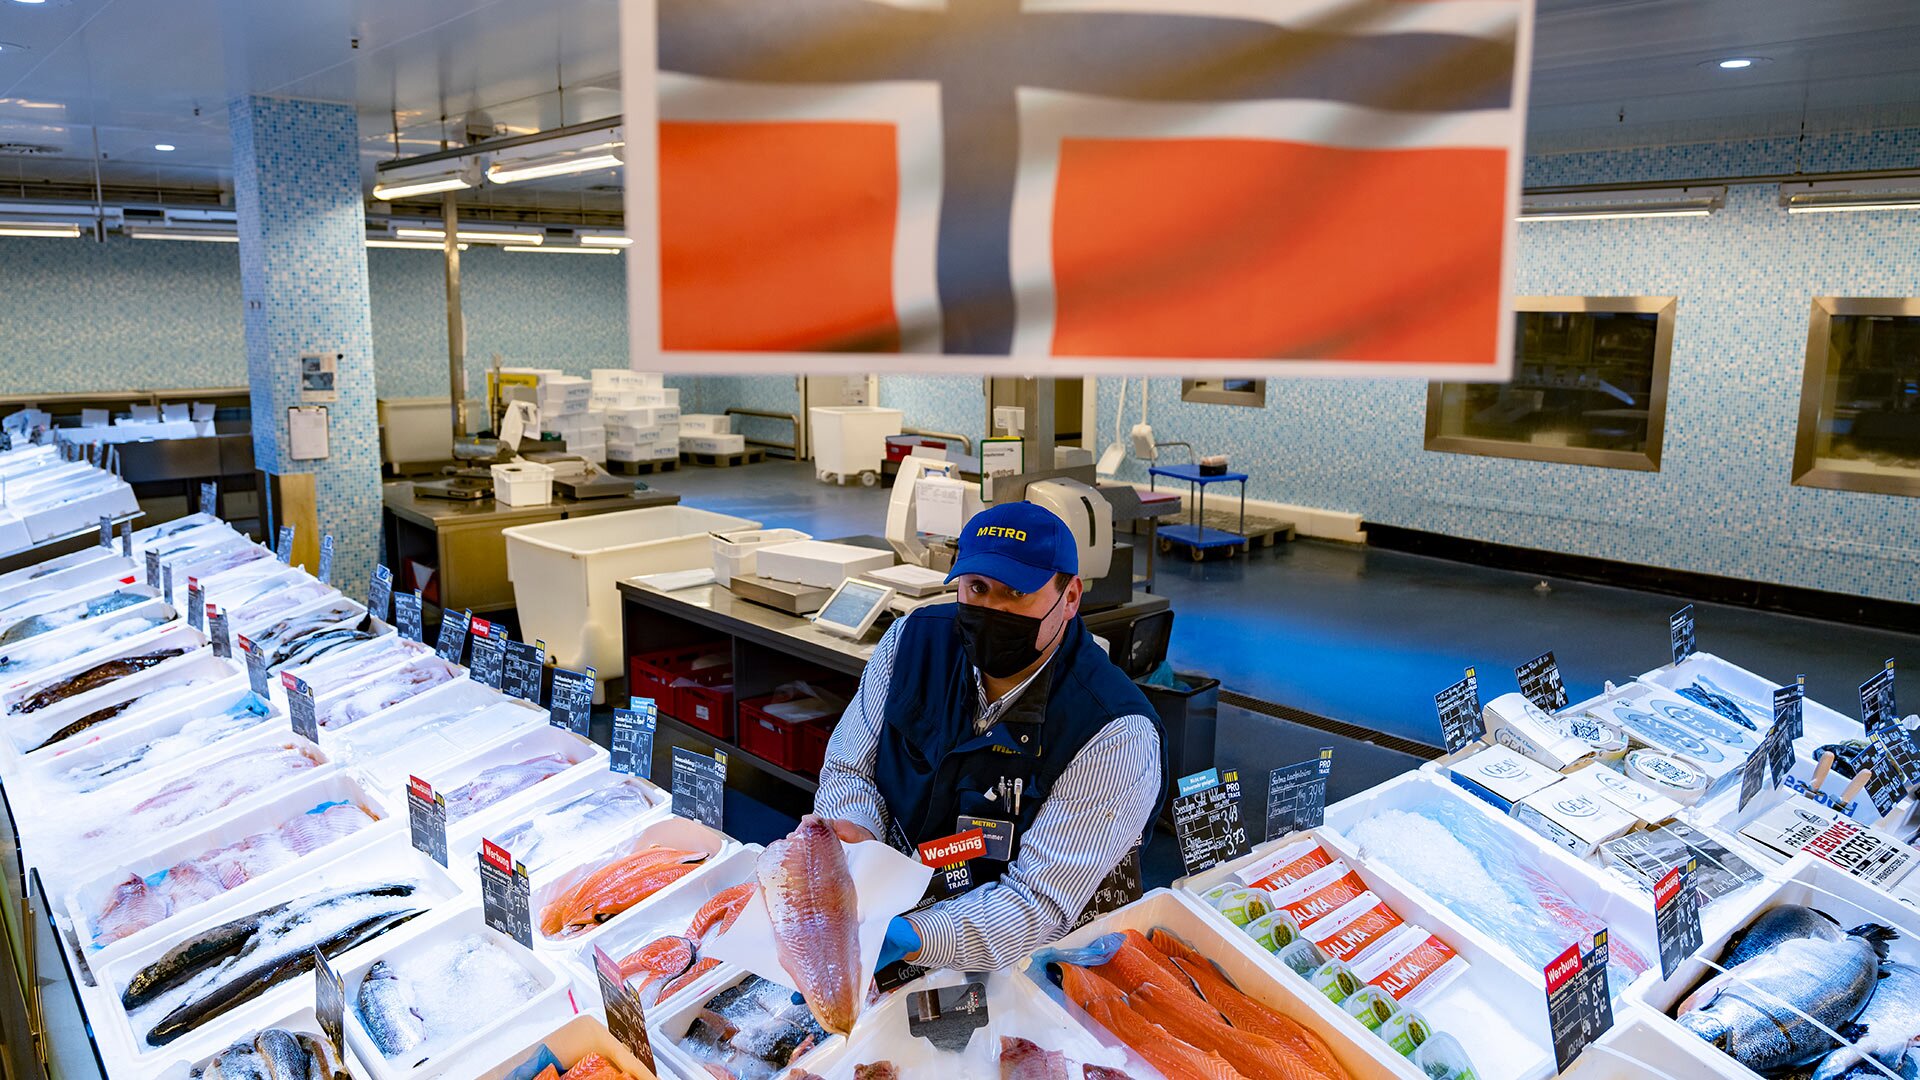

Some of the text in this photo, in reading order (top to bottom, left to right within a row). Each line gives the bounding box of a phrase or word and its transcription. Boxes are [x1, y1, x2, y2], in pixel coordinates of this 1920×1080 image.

[976, 526, 1027, 542] METRO
[647, 715, 656, 725] PRO
[715, 763, 726, 773] PRO
[1319, 759, 1331, 769] PRO
[1484, 757, 1520, 774] GEAY
[1226, 783, 1240, 793] PRO
[1227, 791, 1241, 799] TRACE
[1557, 793, 1593, 815] GEAY
[971, 819, 997, 829] METRO
[1221, 805, 1238, 834] 3,49
[983, 833, 1005, 842] ammer
[1226, 828, 1246, 856] 3,73
[1568, 838, 1577, 849] 2
[1784, 825, 1819, 849] PREMIER
[484, 844, 510, 871] Werbung
[924, 838, 982, 862] Werbung
[945, 868, 968, 884] PRO
[947, 878, 970, 890] TRACE
[1655, 872, 1680, 901] Werbung
[1291, 879, 1362, 926] ALMA LOIN
[1595, 944, 1608, 957] PRO
[1547, 953, 1579, 984] Werbung
[1381, 962, 1425, 995] ALMA
